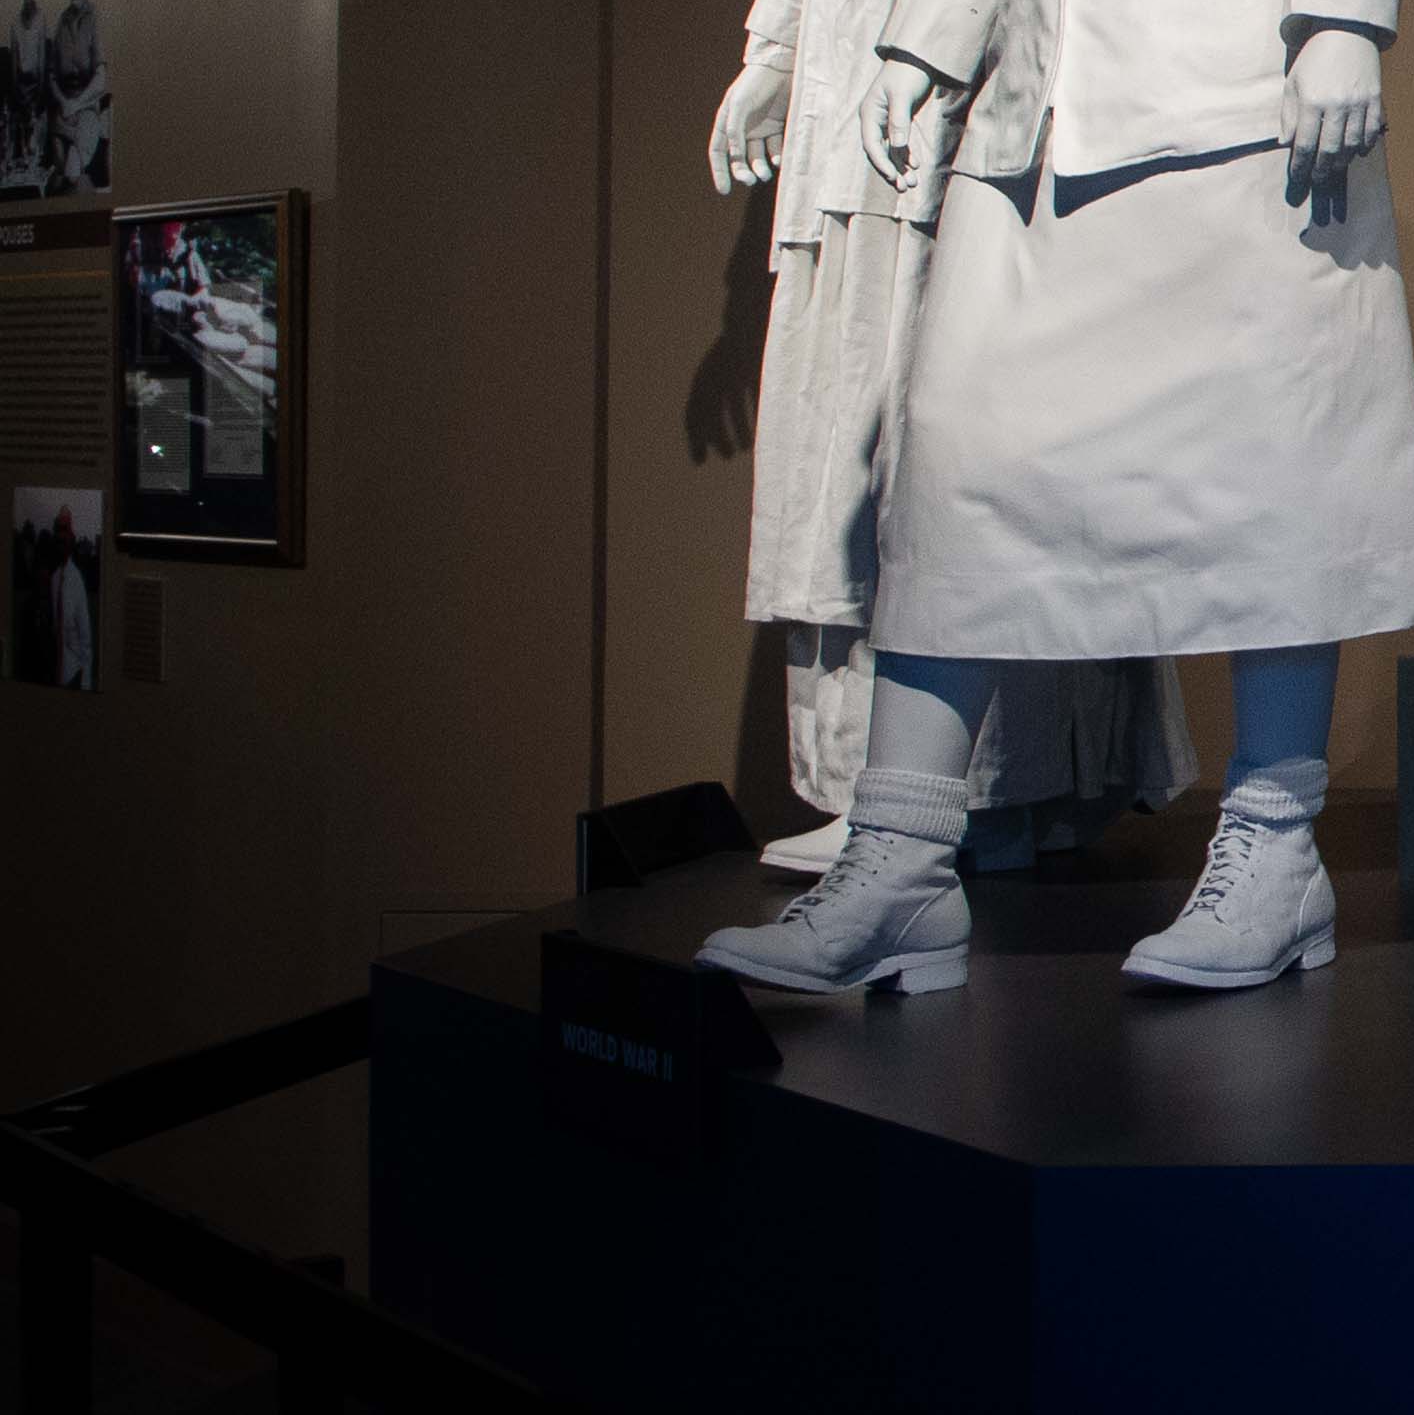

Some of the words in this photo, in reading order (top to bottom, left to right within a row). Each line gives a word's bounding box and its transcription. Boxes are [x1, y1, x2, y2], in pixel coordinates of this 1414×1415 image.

[560, 1019, 618, 1063] WORLD
[623, 1039, 657, 1077] WAR
[662, 1049, 673, 1083] II
